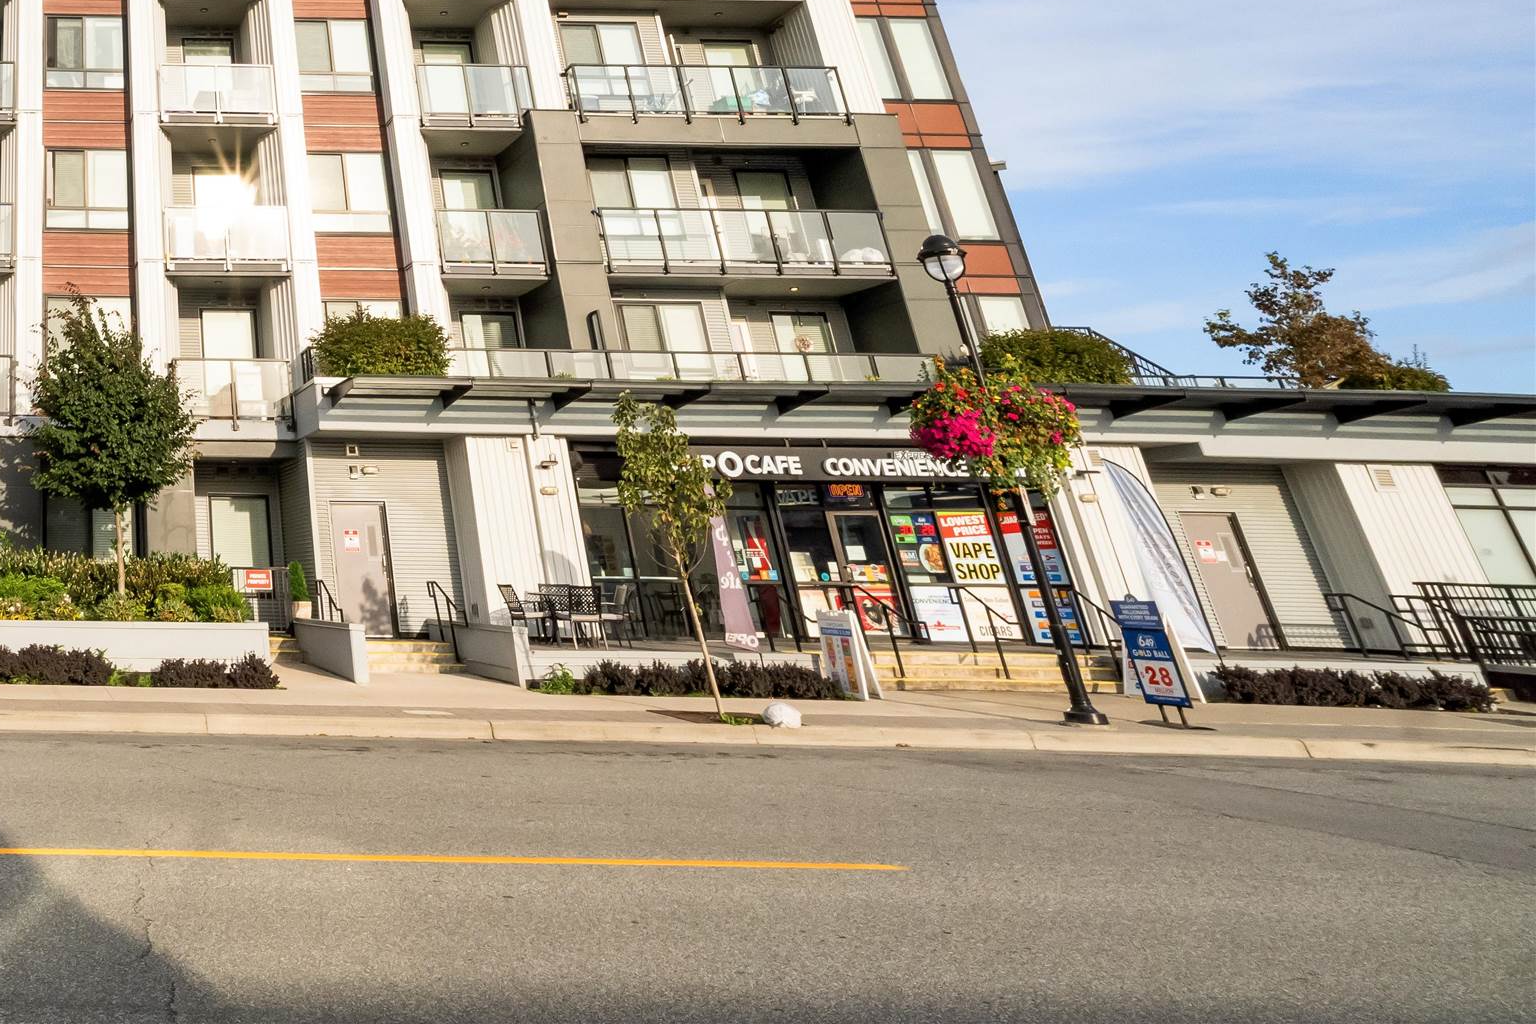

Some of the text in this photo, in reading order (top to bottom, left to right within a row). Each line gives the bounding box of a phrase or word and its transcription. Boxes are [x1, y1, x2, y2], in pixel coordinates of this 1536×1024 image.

[744, 454, 804, 476] CAFE
[824, 456, 971, 478] CONVENIENCE
[829, 483, 864, 497] OPEN
[940, 515, 985, 527] LOWEST
[953, 524, 988, 536] PRICE
[950, 542, 995, 559] VAPE
[955, 563, 1000, 580] SHOP
